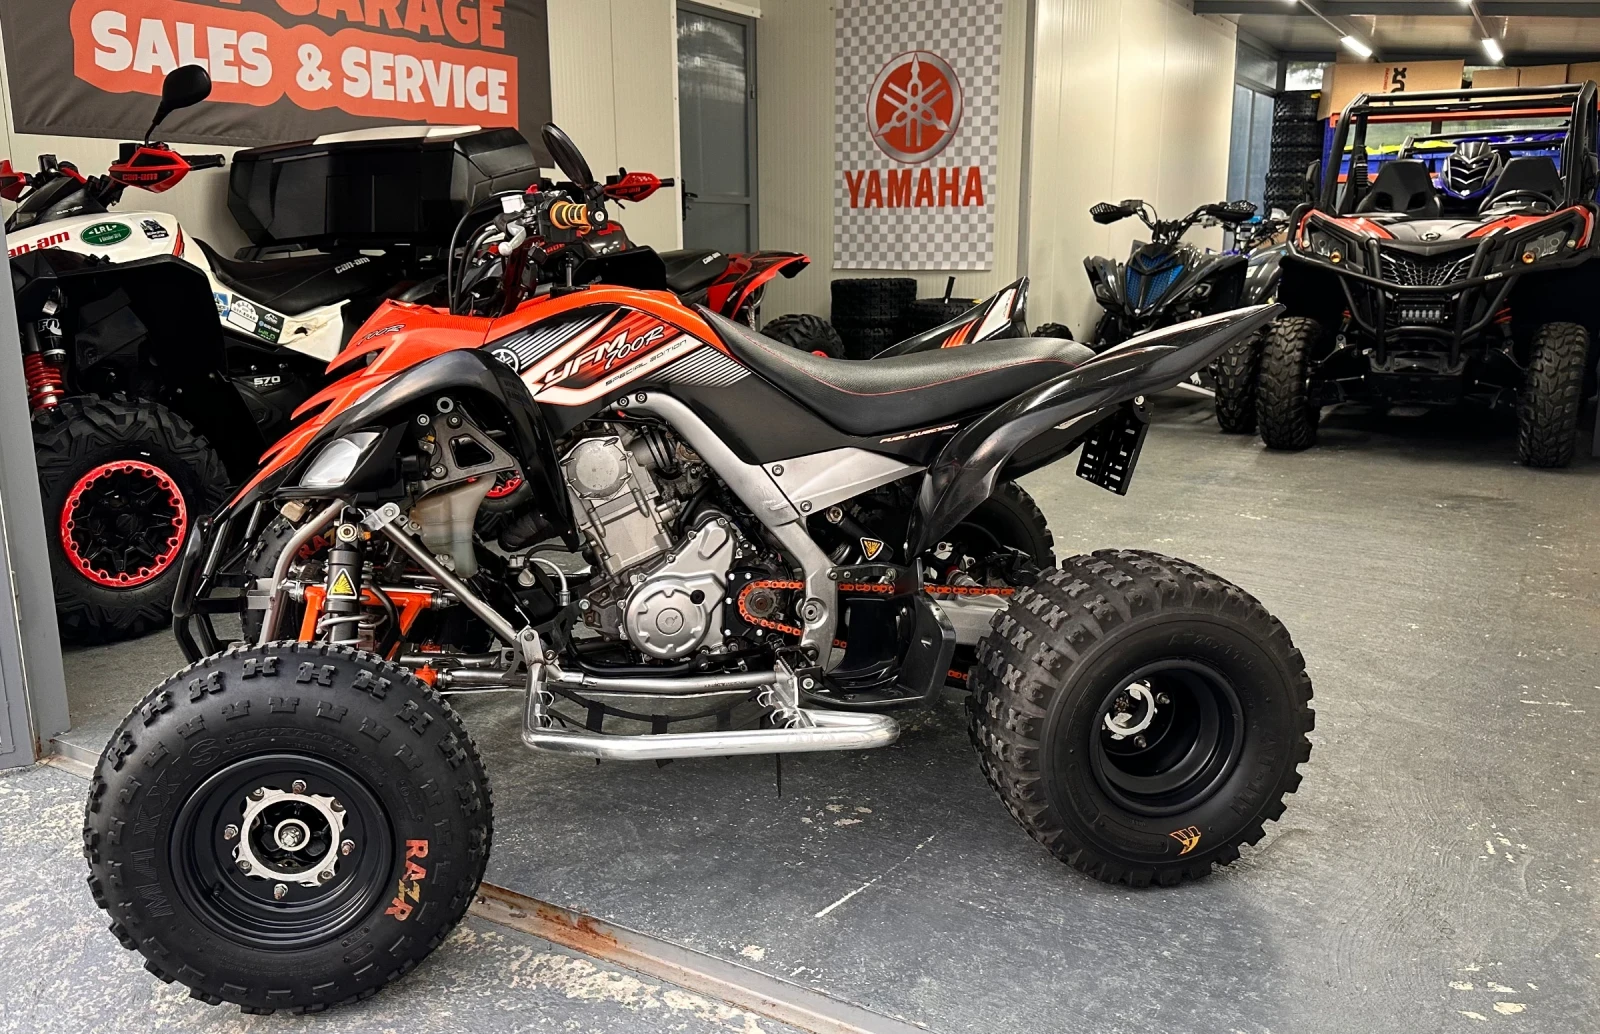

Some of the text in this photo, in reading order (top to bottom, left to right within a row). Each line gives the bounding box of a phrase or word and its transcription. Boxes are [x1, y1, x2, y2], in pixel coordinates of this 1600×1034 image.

[91, 10, 508, 114] SALES & SERVICE
[845, 166, 985, 208] YAMAHA
[8, 231, 70, 259] an-am
[334, 256, 371, 274] can-am
[603, 325, 666, 371] 700R
[605, 339, 687, 386] SPECIAL EDITION
[384, 839, 429, 921] RAZR
